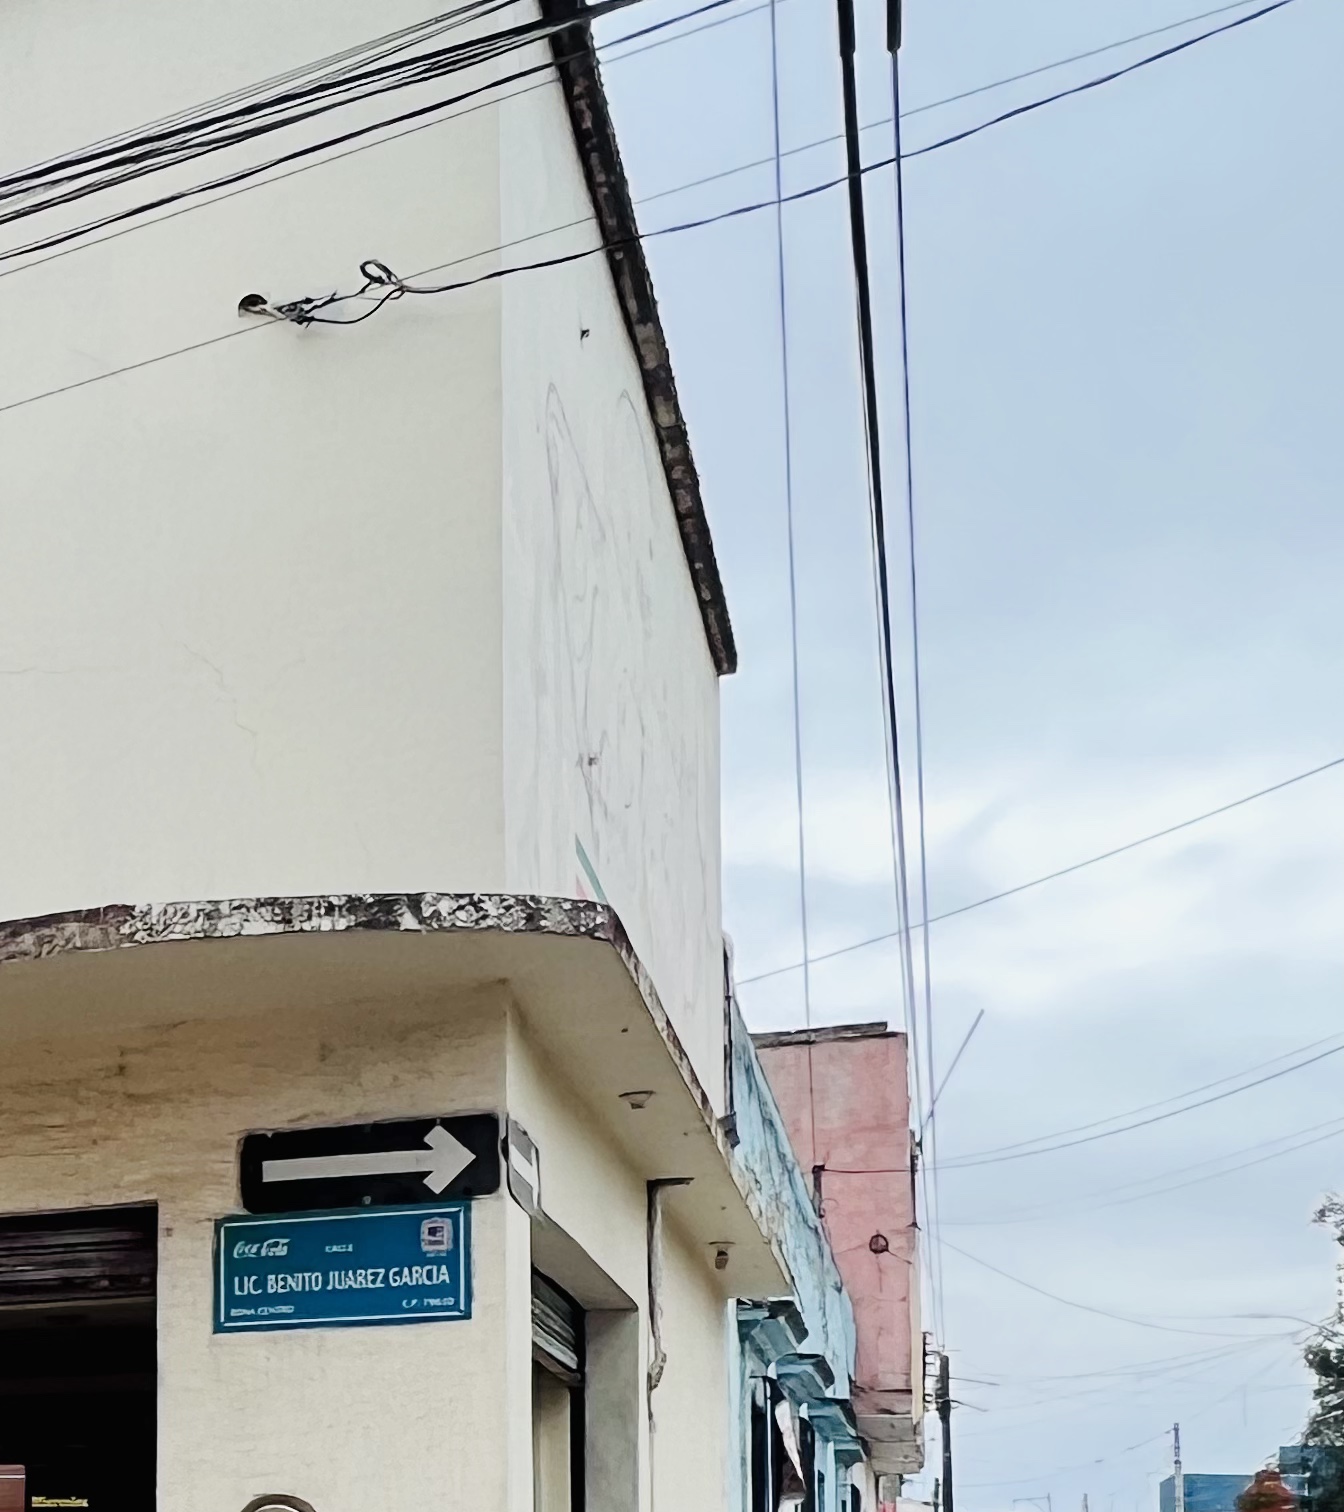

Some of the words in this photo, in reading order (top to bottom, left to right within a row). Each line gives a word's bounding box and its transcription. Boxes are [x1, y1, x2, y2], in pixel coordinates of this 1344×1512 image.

[268, 1271, 322, 1293] BENITO
[327, 1268, 385, 1290] JUAREZ
[389, 1265, 450, 1287] GARCIA
